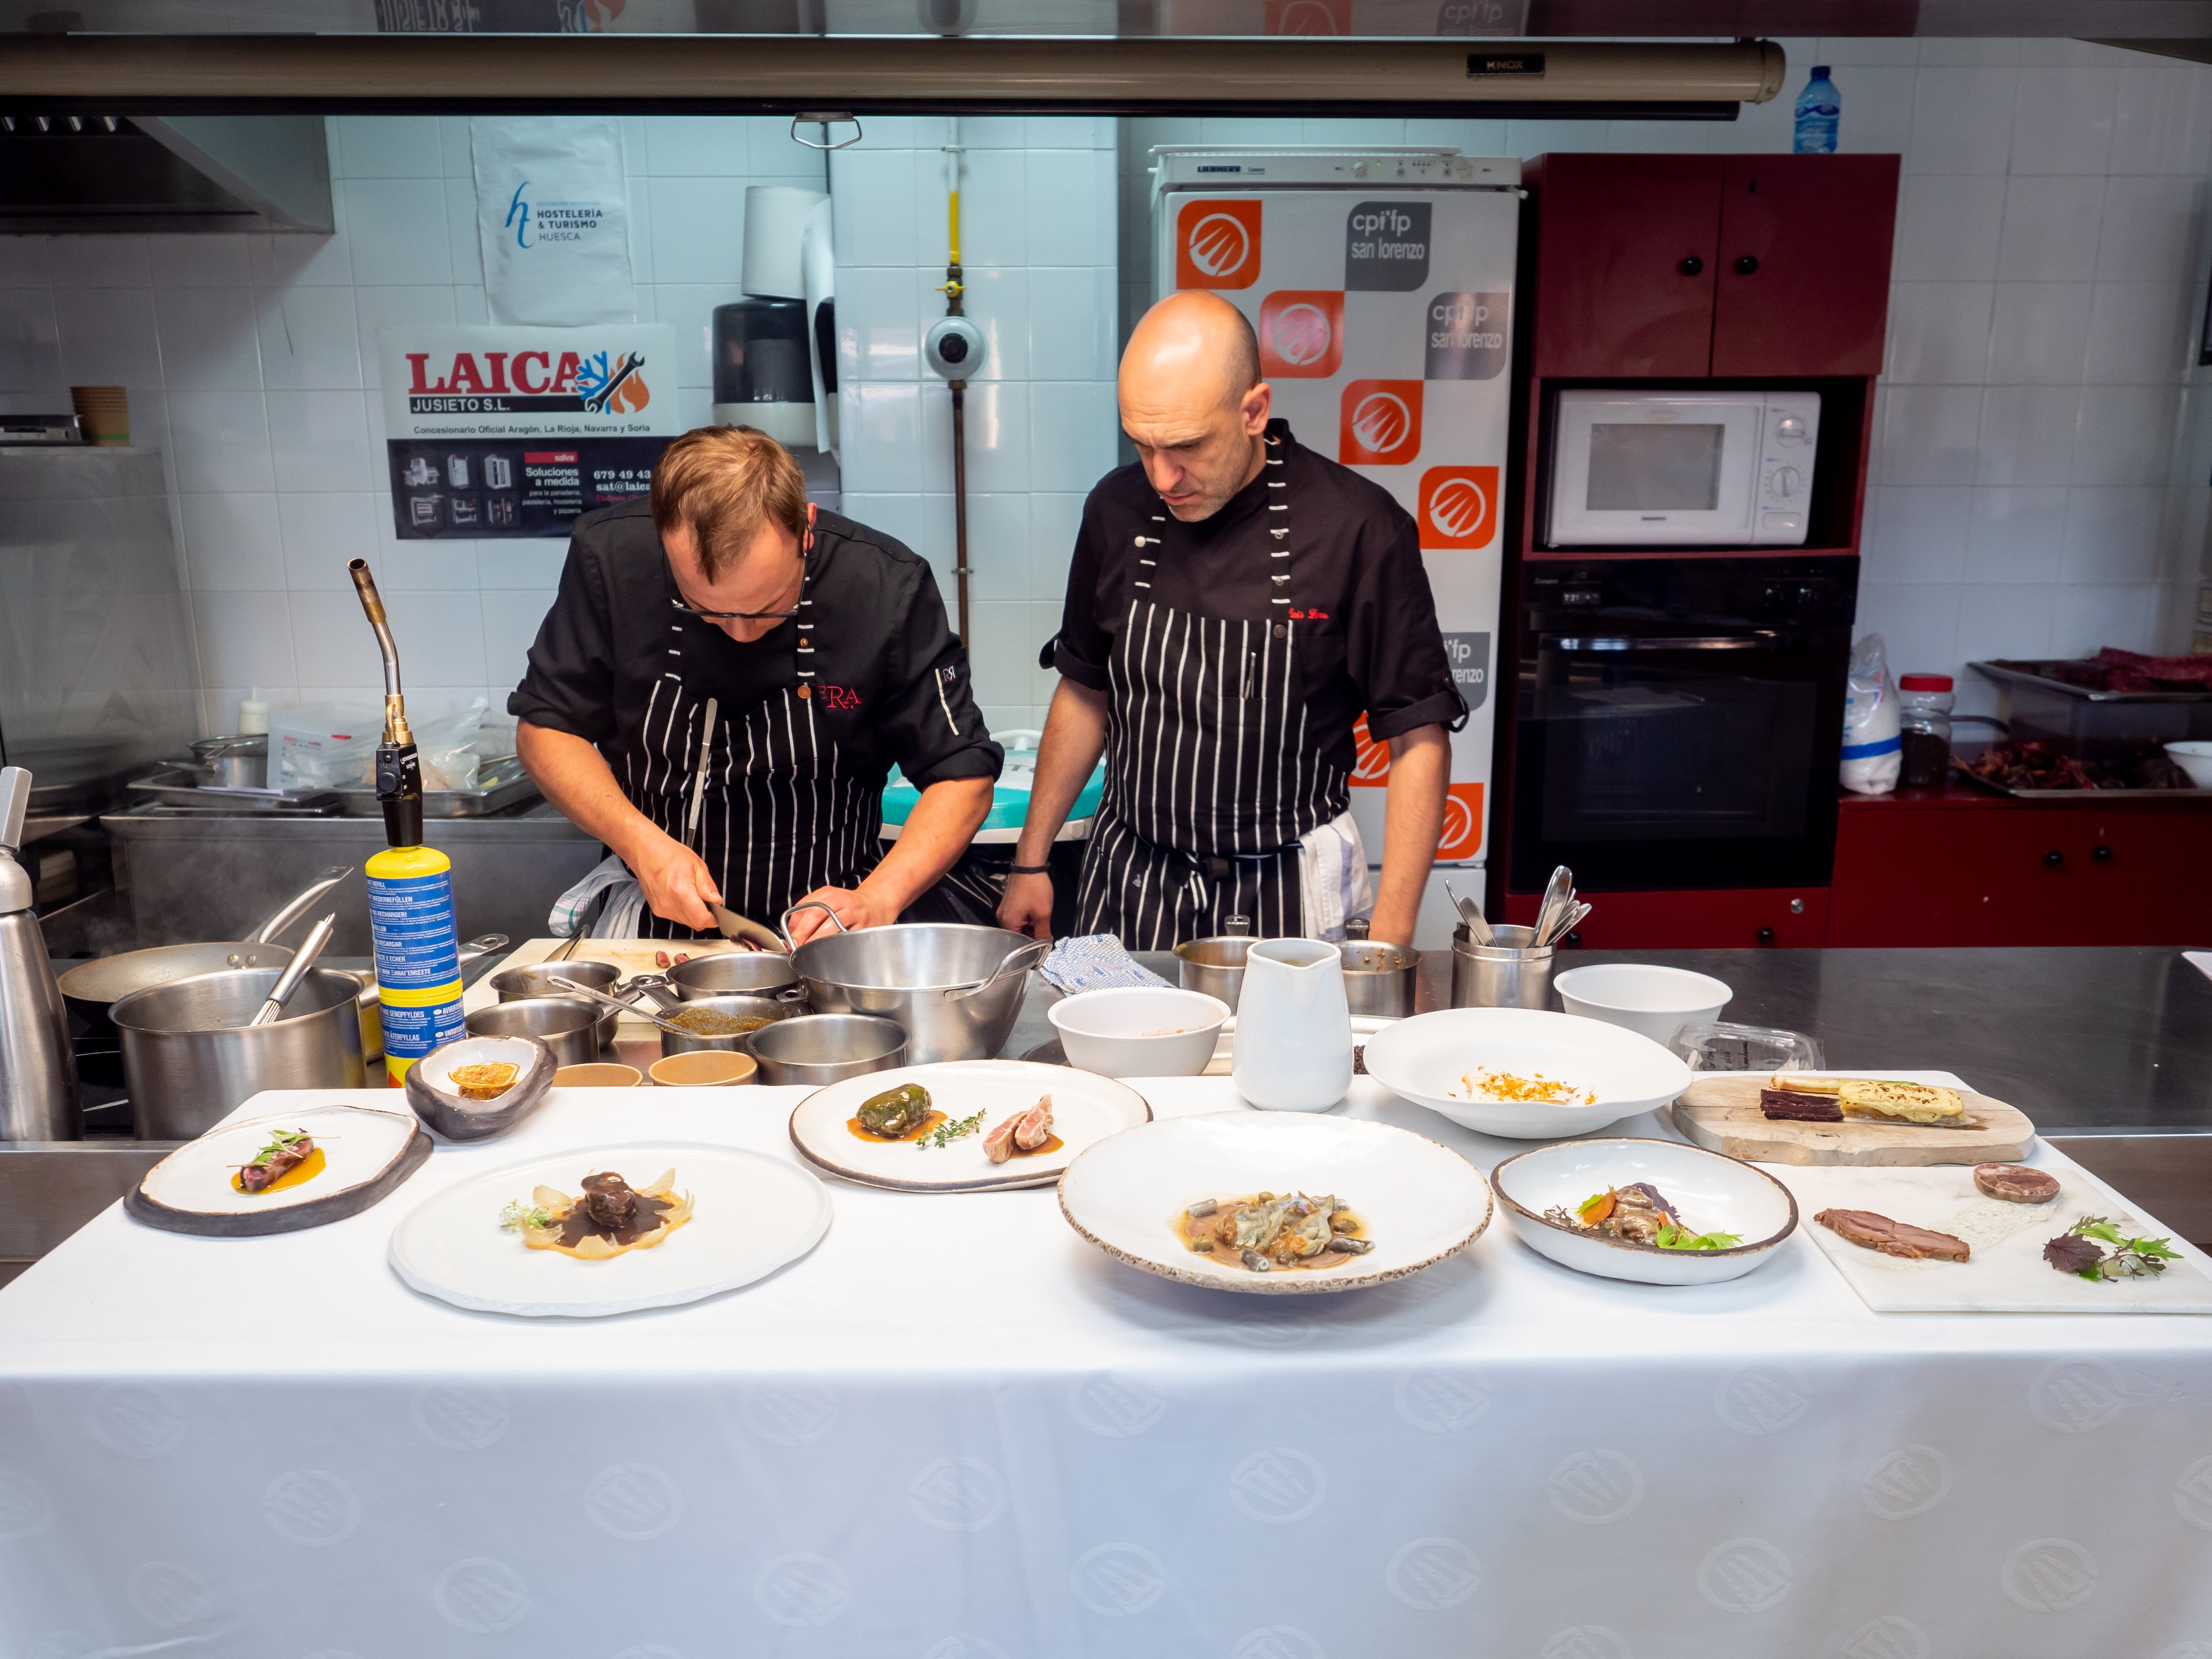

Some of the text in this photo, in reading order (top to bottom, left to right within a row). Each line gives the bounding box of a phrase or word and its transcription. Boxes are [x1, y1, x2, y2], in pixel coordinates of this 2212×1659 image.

[537, 208, 603, 218] HOSTELERÍA
[549, 221, 597, 229] TURISMO
[539, 232, 580, 241] HUESCA
[1352, 238, 1424, 259] san lorenzo
[1432, 331, 1453, 348] san
[406, 351, 589, 394] LAICA
[413, 398, 510, 411] JUSIETO S.L.
[508, 426, 541, 435] Aragón,
[558, 425, 581, 434] Rioja,
[585, 424, 617, 432] Navarra
[628, 424, 650, 432] Soria
[525, 467, 578, 477] Soluciones
[593, 470, 651, 479] 679 49 43
[544, 477, 579, 486] medida
[1452, 669, 1484, 683] renzo
[389, 1010, 425, 1019] GENOPFYLDES
[390, 1031, 420, 1041] ÅTERFYLLAS
